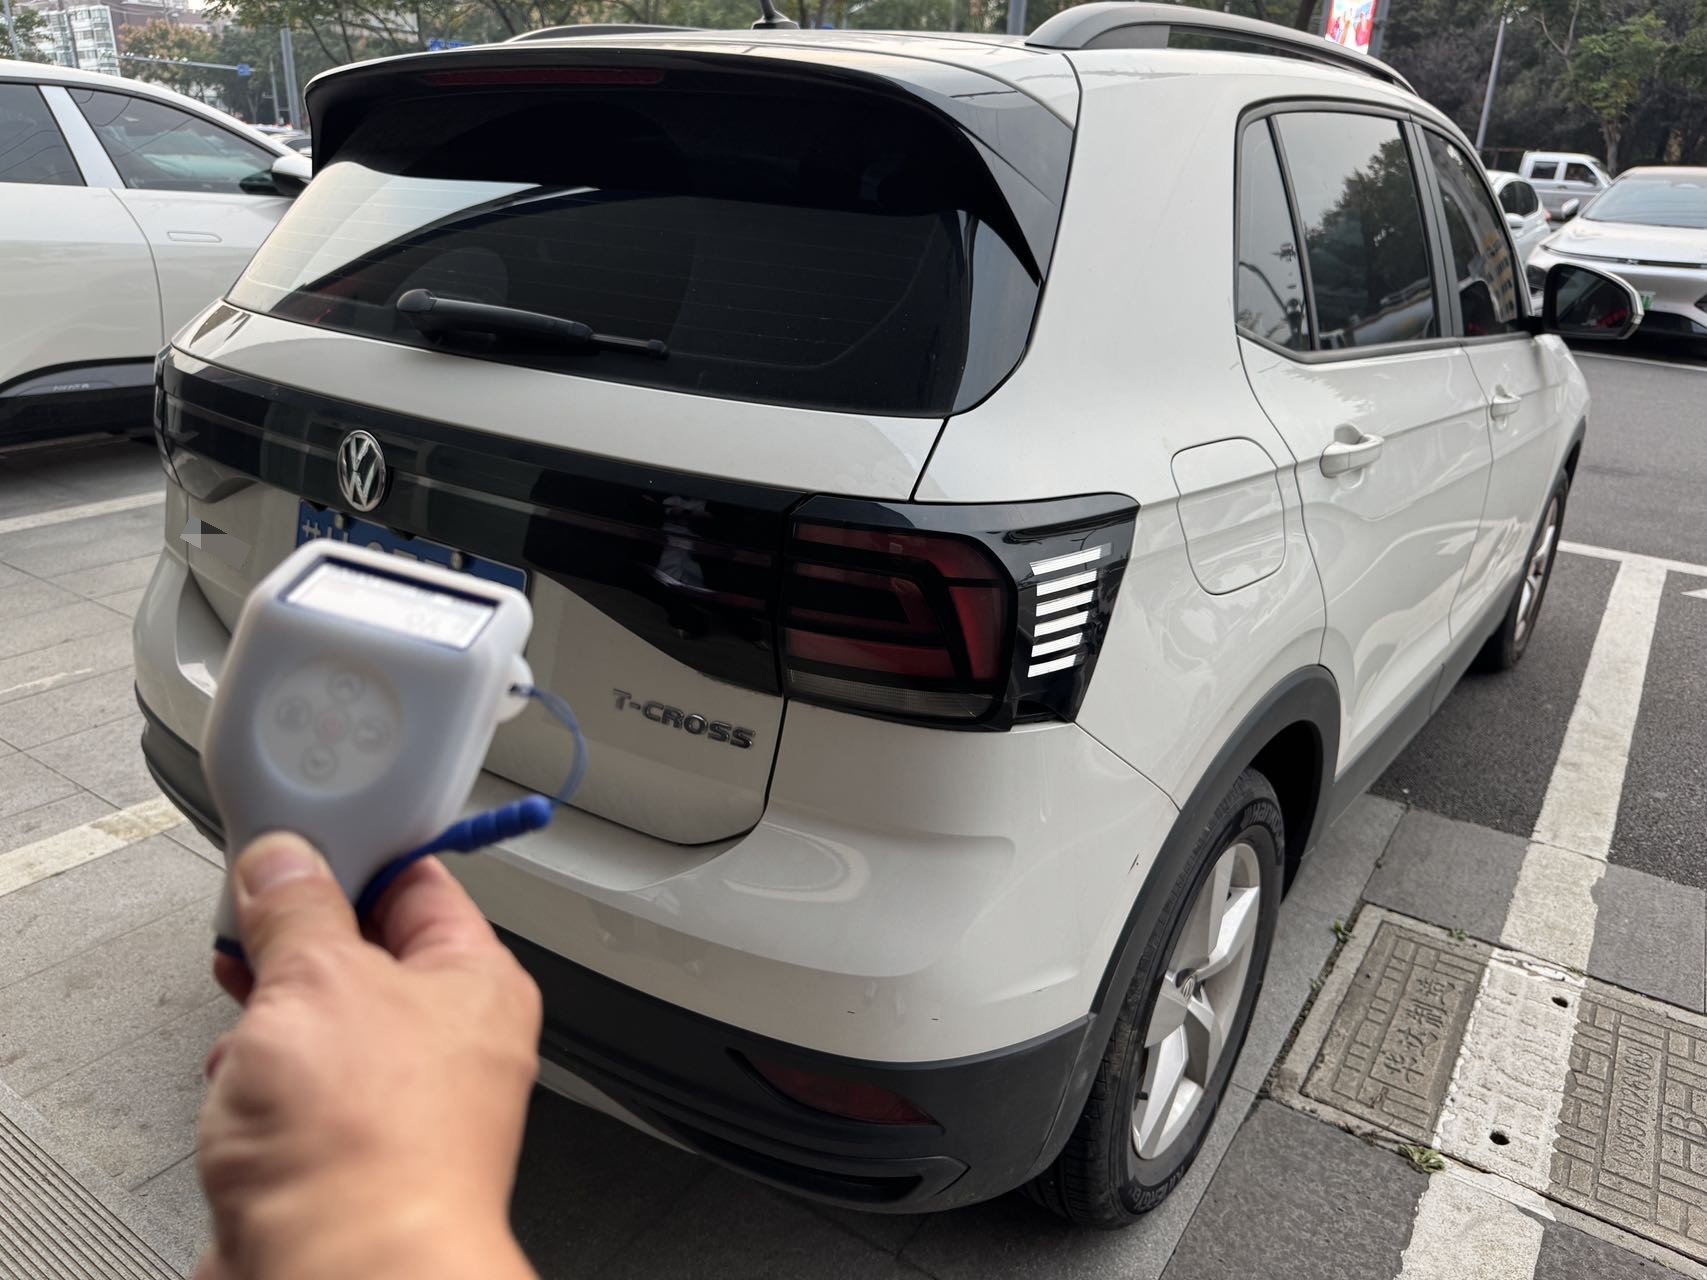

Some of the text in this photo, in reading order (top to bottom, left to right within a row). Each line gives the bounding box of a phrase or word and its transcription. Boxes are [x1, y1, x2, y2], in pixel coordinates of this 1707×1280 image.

[612, 688, 756, 749] T-CROSS
[1381, 978, 1456, 1084] 华达制造
